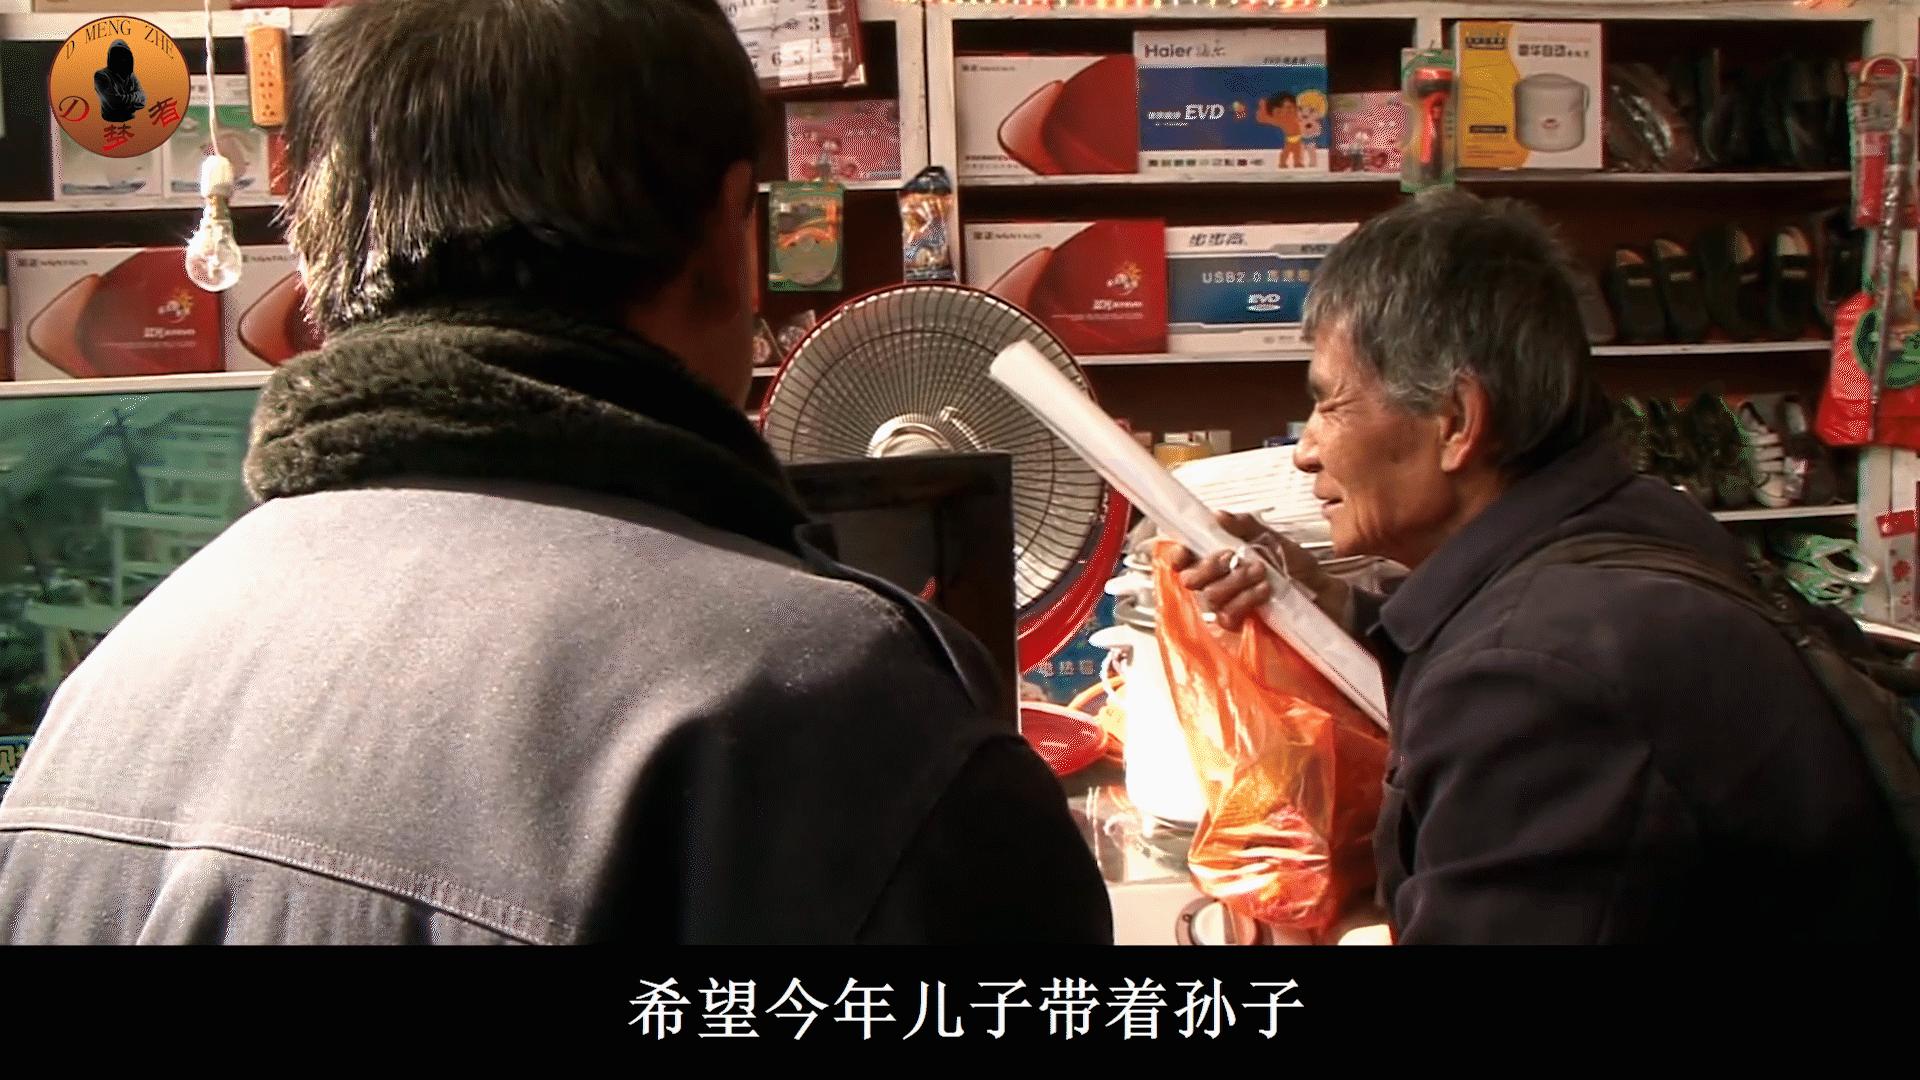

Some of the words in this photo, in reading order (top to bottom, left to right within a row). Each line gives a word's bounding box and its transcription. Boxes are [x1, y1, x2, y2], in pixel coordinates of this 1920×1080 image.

[808, 16, 820, 32] 3
[1145, 43, 1194, 58] Haier
[1184, 103, 1225, 120] EVD
[1189, 231, 1248, 248] 步步高
[1248, 293, 1281, 304] EVD
